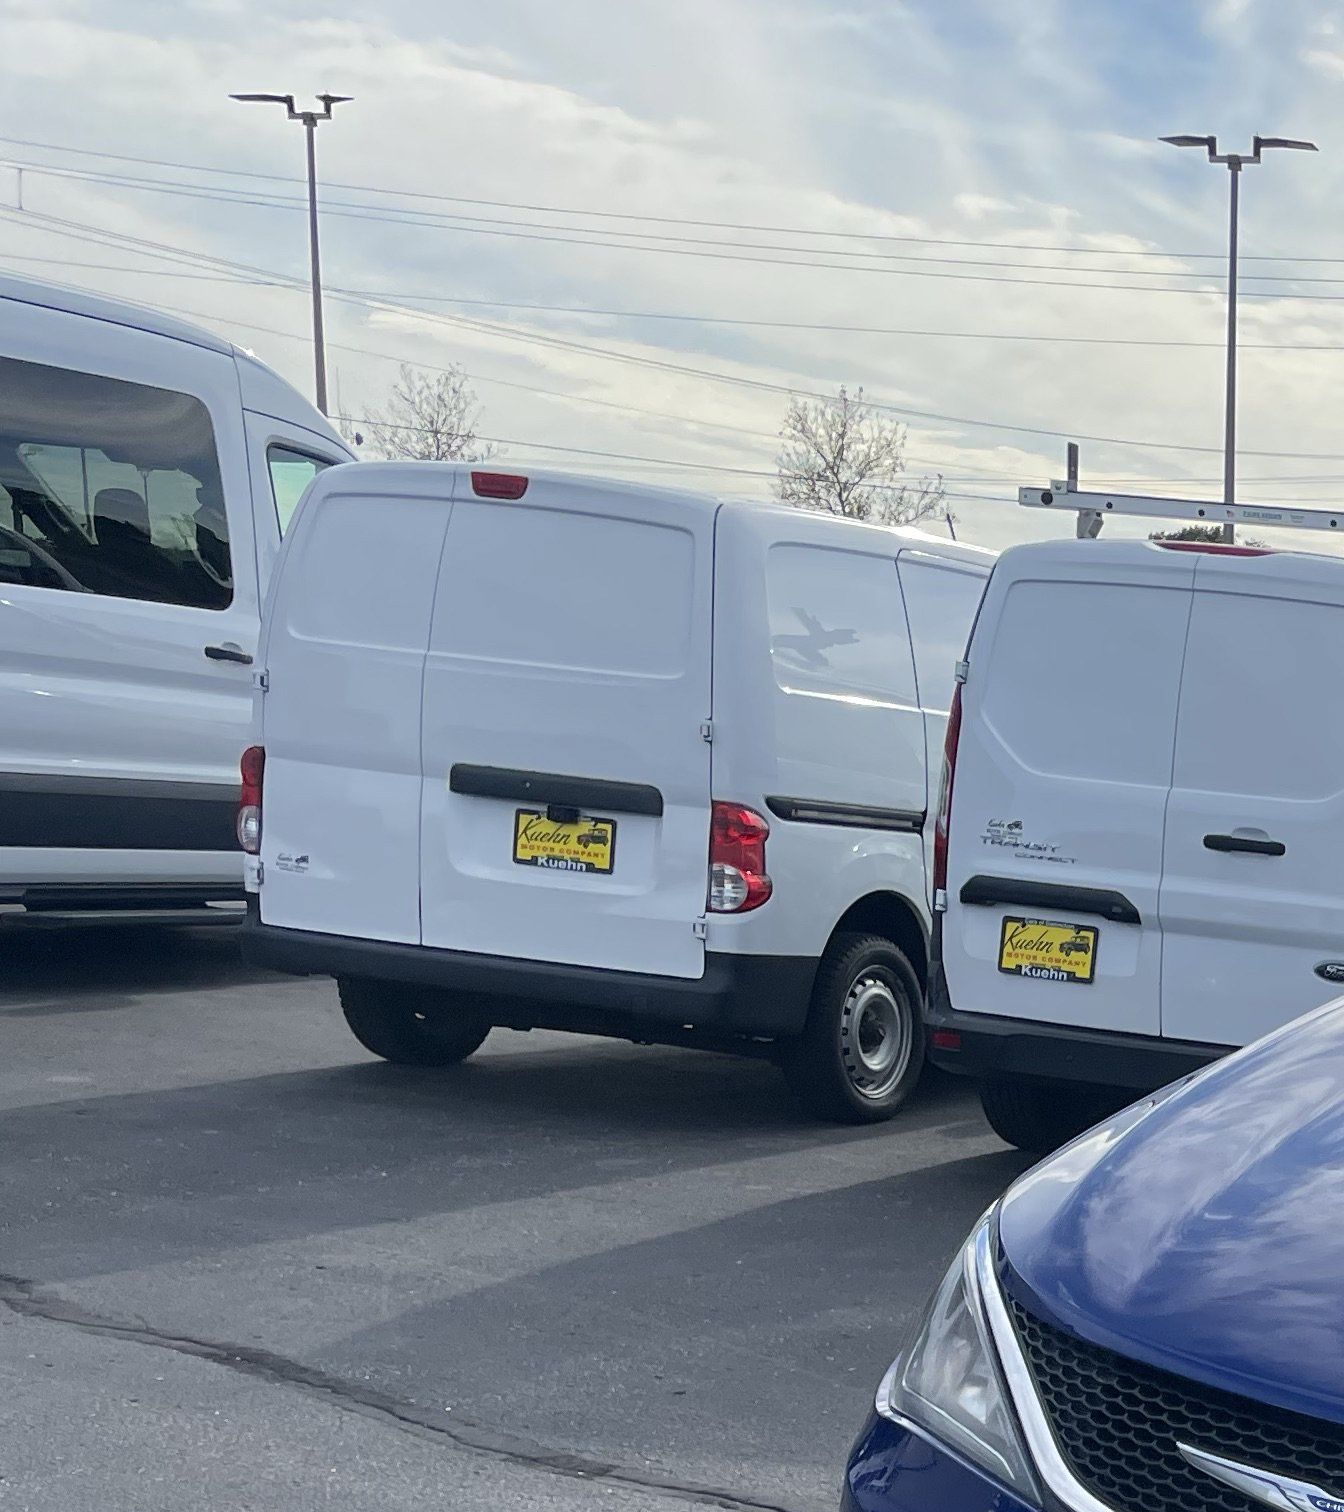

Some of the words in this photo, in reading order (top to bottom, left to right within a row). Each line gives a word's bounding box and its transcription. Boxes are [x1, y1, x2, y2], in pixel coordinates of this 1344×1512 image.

[518, 818, 571, 846] Kuehn
[520, 843, 555, 853] MOTOR
[559, 849, 606, 859] COMPANY
[536, 856, 587, 872] Kuehn
[1003, 925, 1055, 954] Kuehn
[1006, 951, 1038, 961] MOTOR
[1041, 956, 1087, 968] COMPANY
[1020, 964, 1068, 981] Kuehn
